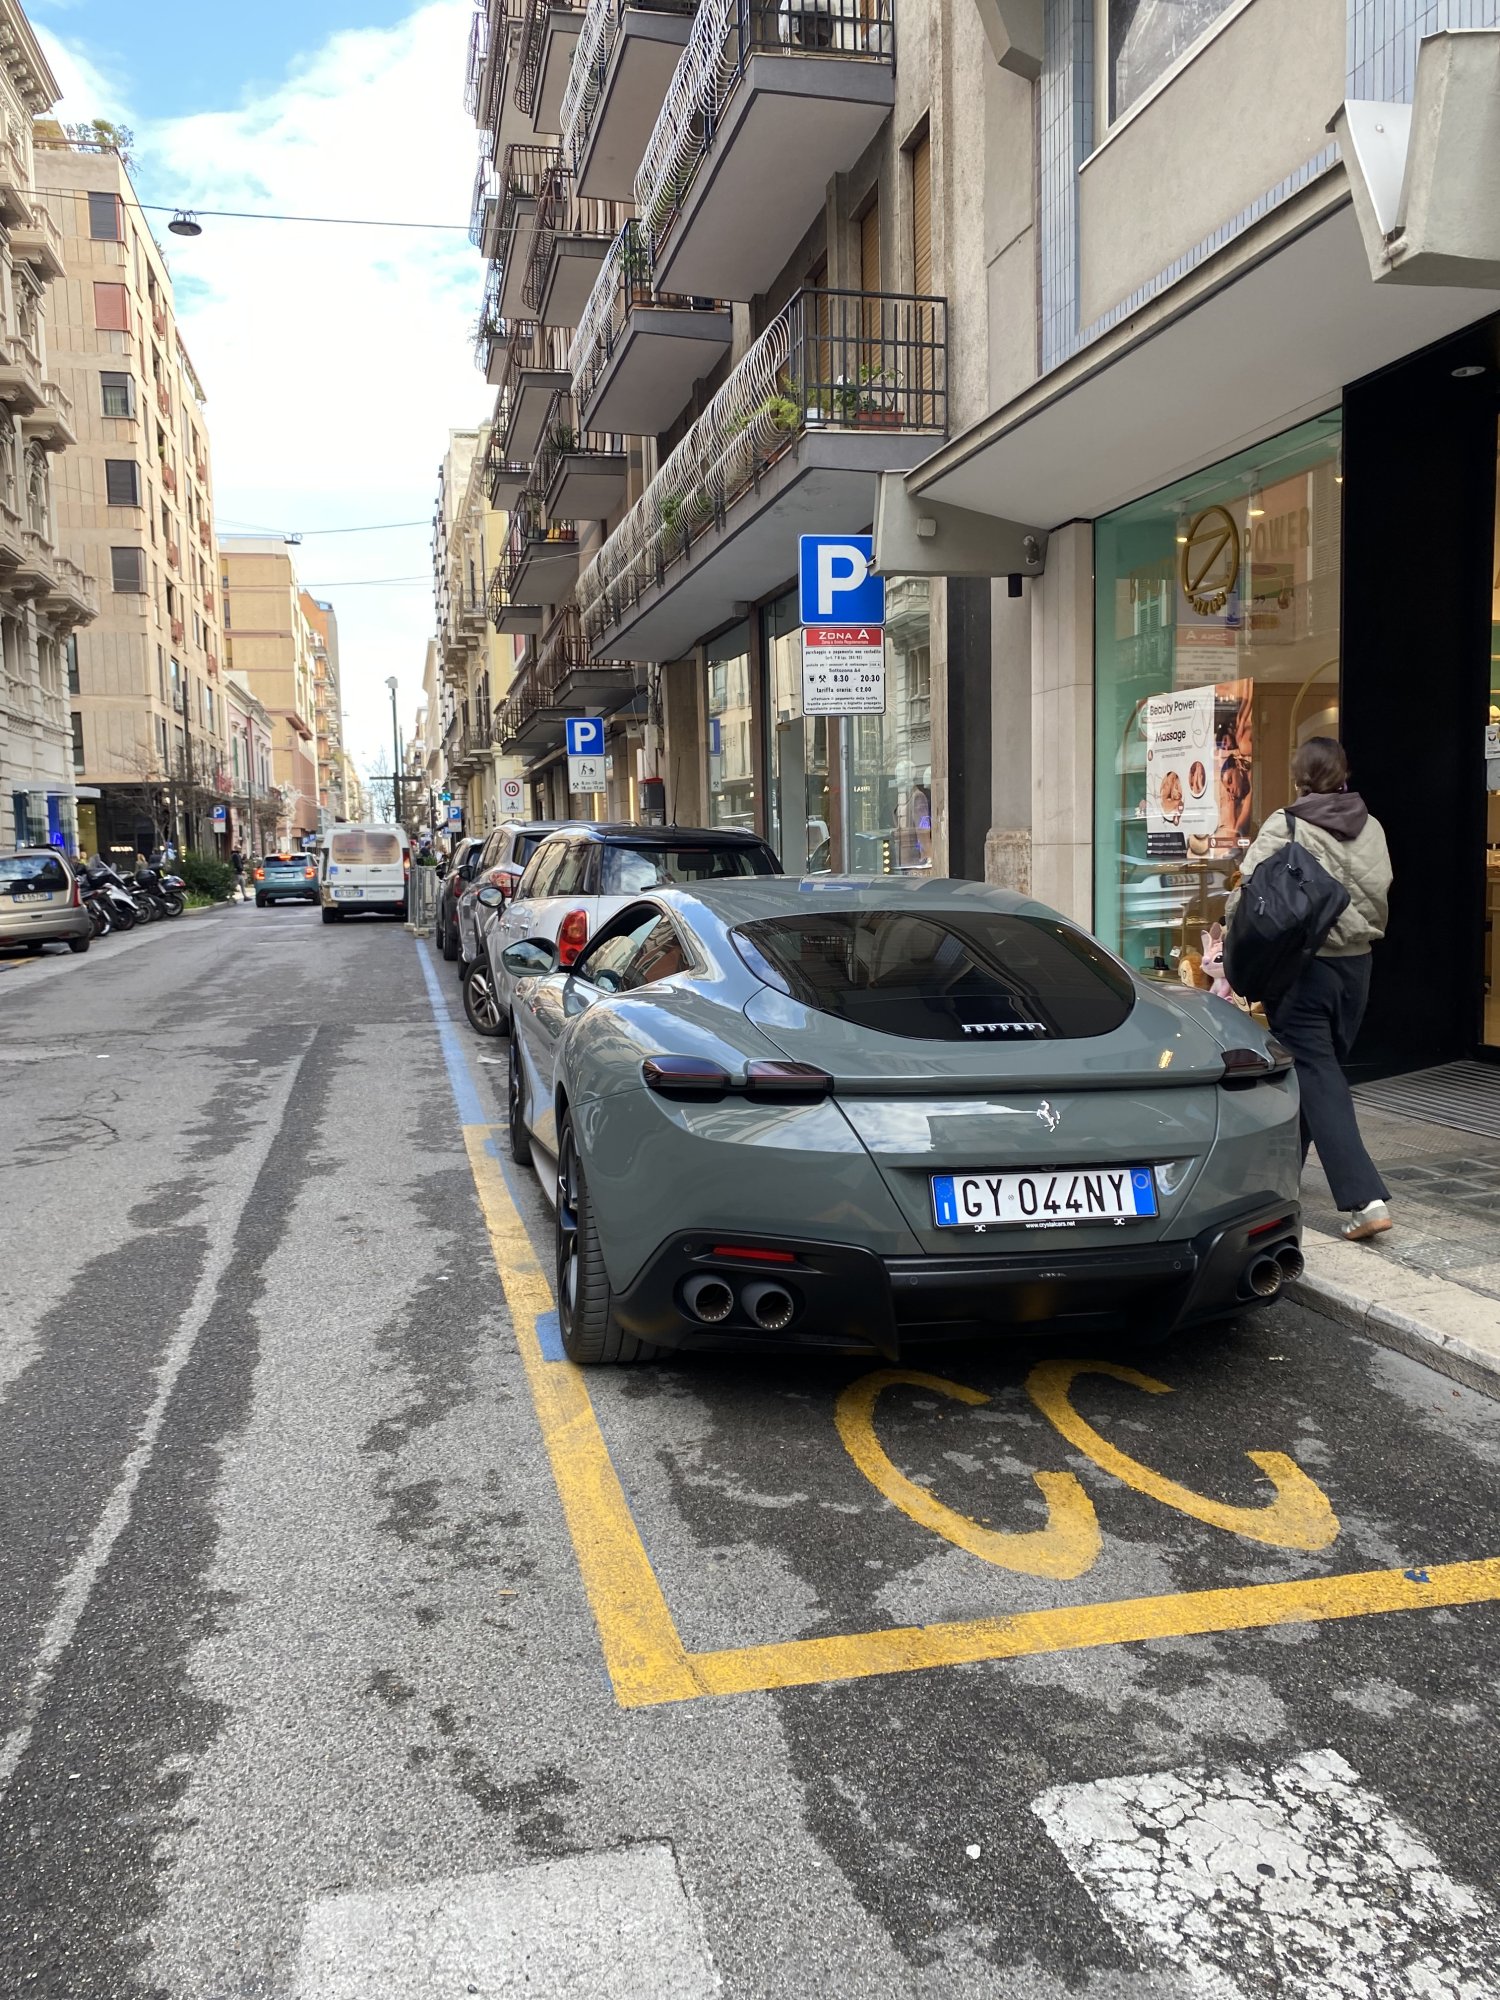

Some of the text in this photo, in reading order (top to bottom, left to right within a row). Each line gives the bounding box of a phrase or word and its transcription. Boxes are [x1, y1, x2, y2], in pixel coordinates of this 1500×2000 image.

[1244, 507, 1309, 562] POWER
[818, 544, 868, 614] P
[819, 629, 869, 640] ZONA A
[1150, 700, 1196, 716] Beauty Power
[574, 722, 596, 752] P
[1155, 729, 1186, 743] Massage
[214, 806, 222, 818] P
[450, 808, 458, 818] P
[962, 1022, 1046, 1033] Ferrari
[962, 1178, 1003, 1217] GY
[1018, 1174, 1124, 1215] 044NY
[1025, 1220, 1076, 1229] www.crystalcars.net
